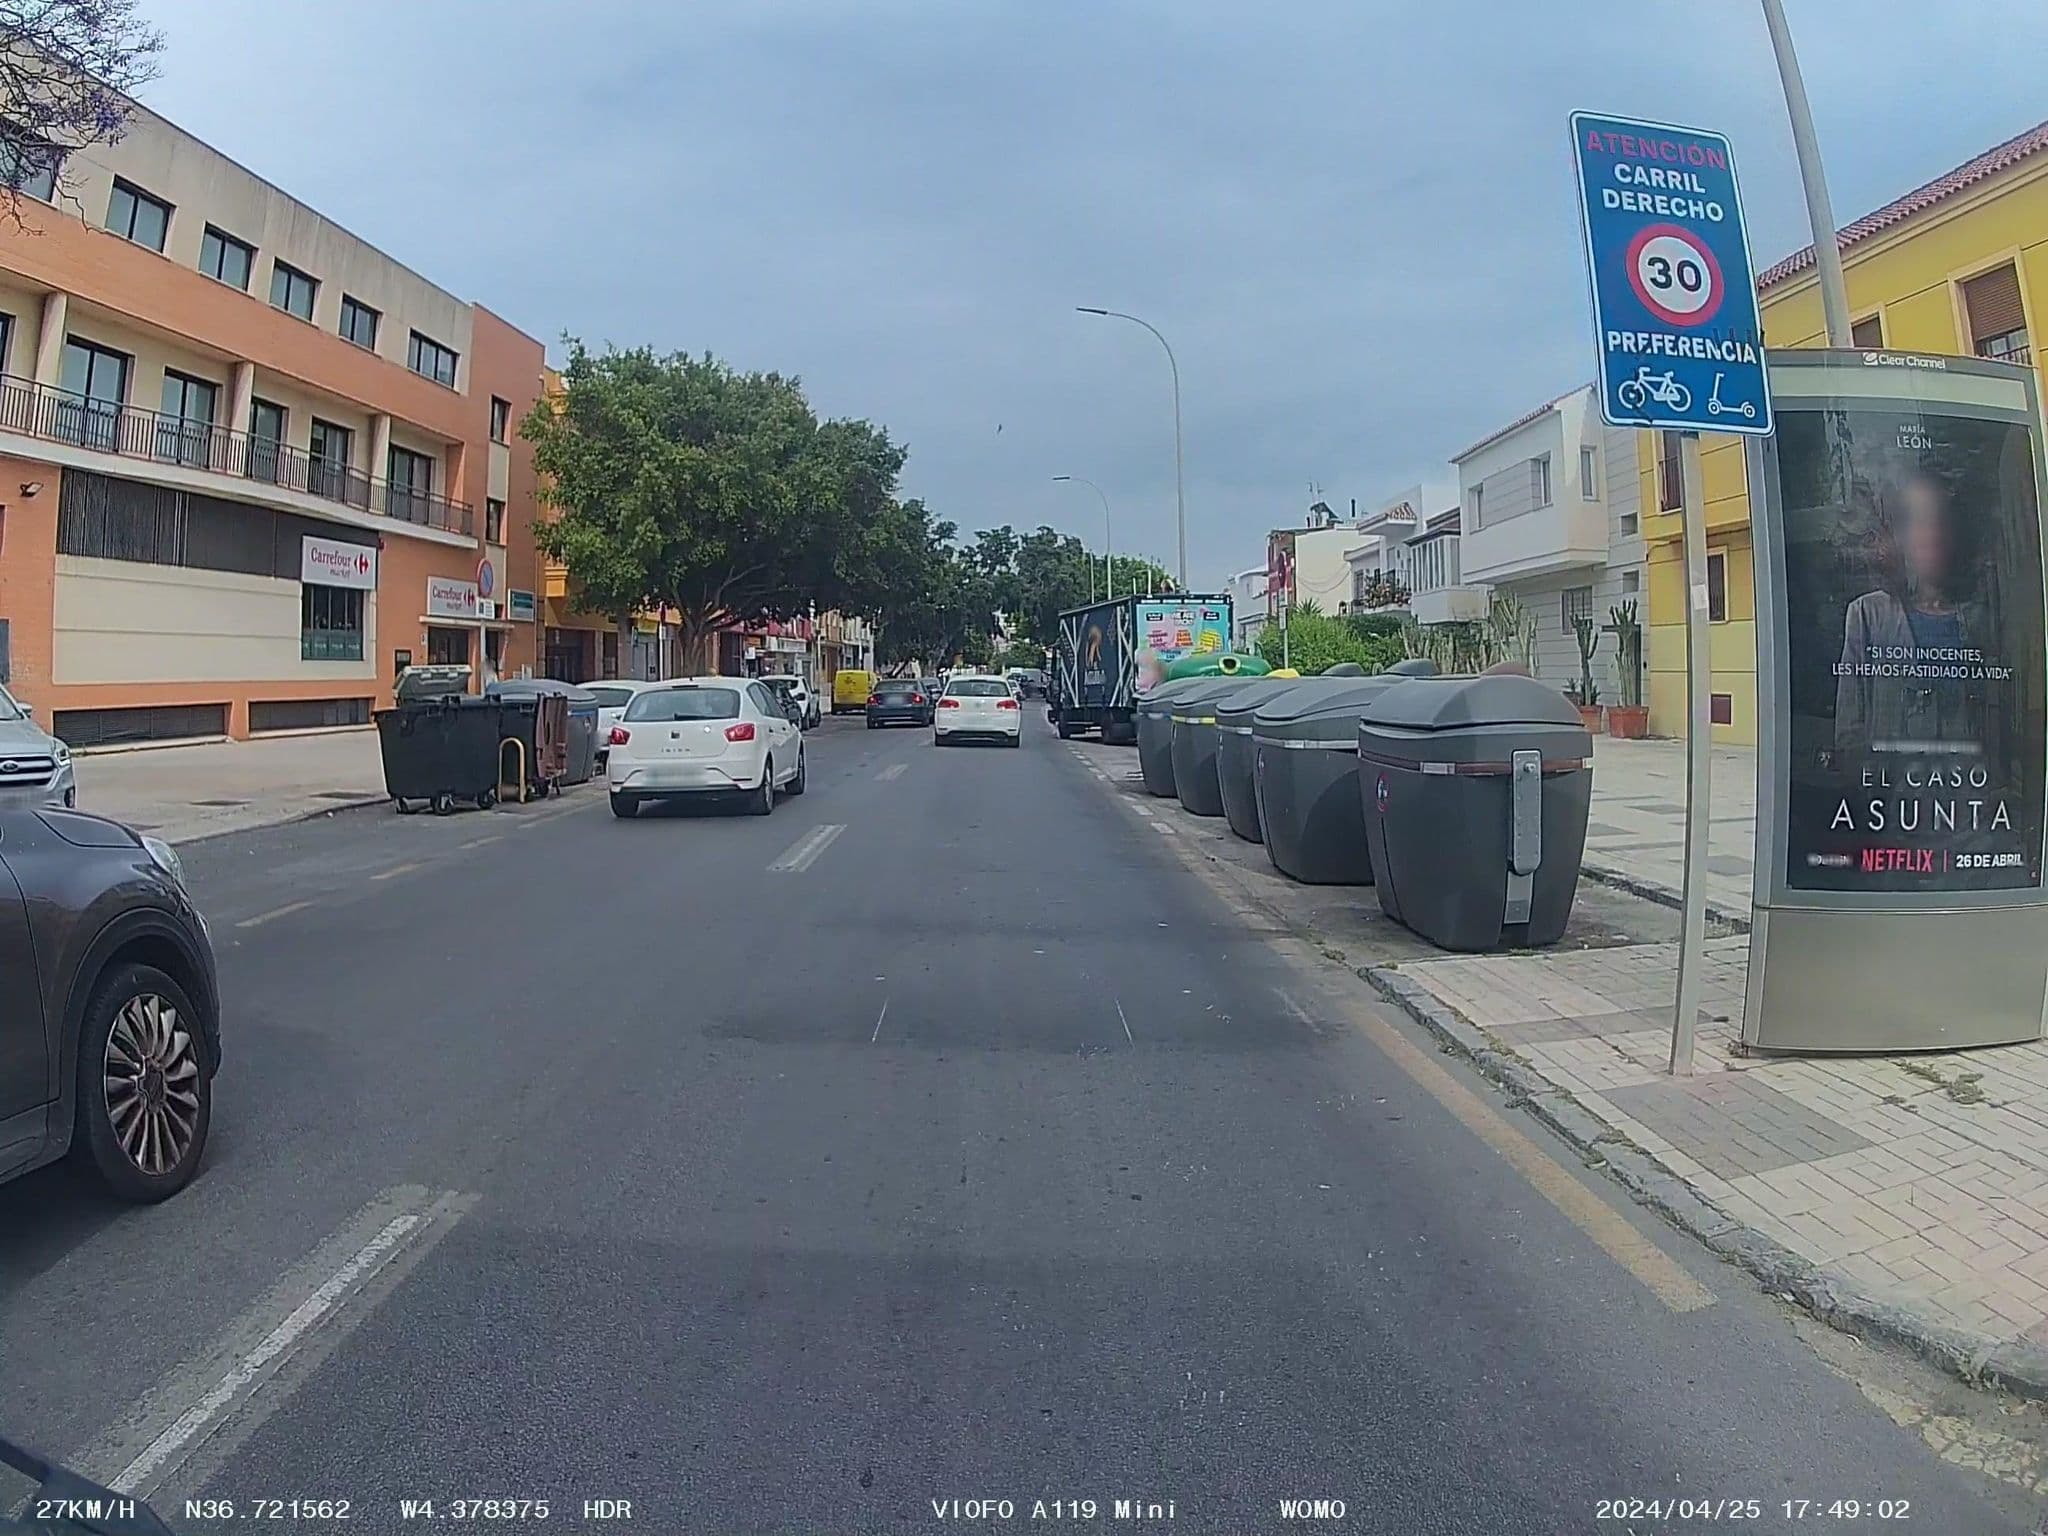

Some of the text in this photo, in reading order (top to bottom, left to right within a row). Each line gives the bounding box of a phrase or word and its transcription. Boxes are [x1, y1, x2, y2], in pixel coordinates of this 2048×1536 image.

[1586, 130, 1726, 170] ATENCIÓN
[1614, 164, 1706, 193] CARRIL
[1602, 188, 1724, 222] DERECHO
[1648, 257, 1701, 292] 30
[1608, 330, 1757, 365] PREFERENCIA
[1879, 354, 1946, 369] Clear Channel
[1896, 434, 1932, 449] LEÓN
[311, 547, 351, 567] Carrefour
[433, 585, 462, 601] Carrefour
[1885, 646, 1913, 660] SON
[1916, 648, 1984, 663] INOCENTES,
[1832, 662, 1852, 676] LES
[1855, 663, 1900, 677] HEMOS
[1902, 665, 1969, 680] FASTIDIADO
[1971, 667, 1984, 679] LA
[1861, 765, 1988, 788] EL CASO
[1830, 799, 2012, 831] ASUNTA
[1860, 849, 1934, 873] NETFLIX
[1956, 855, 1972, 868] 26
[1973, 855, 1990, 868] DE
[1991, 854, 2024, 868] ABRIL
